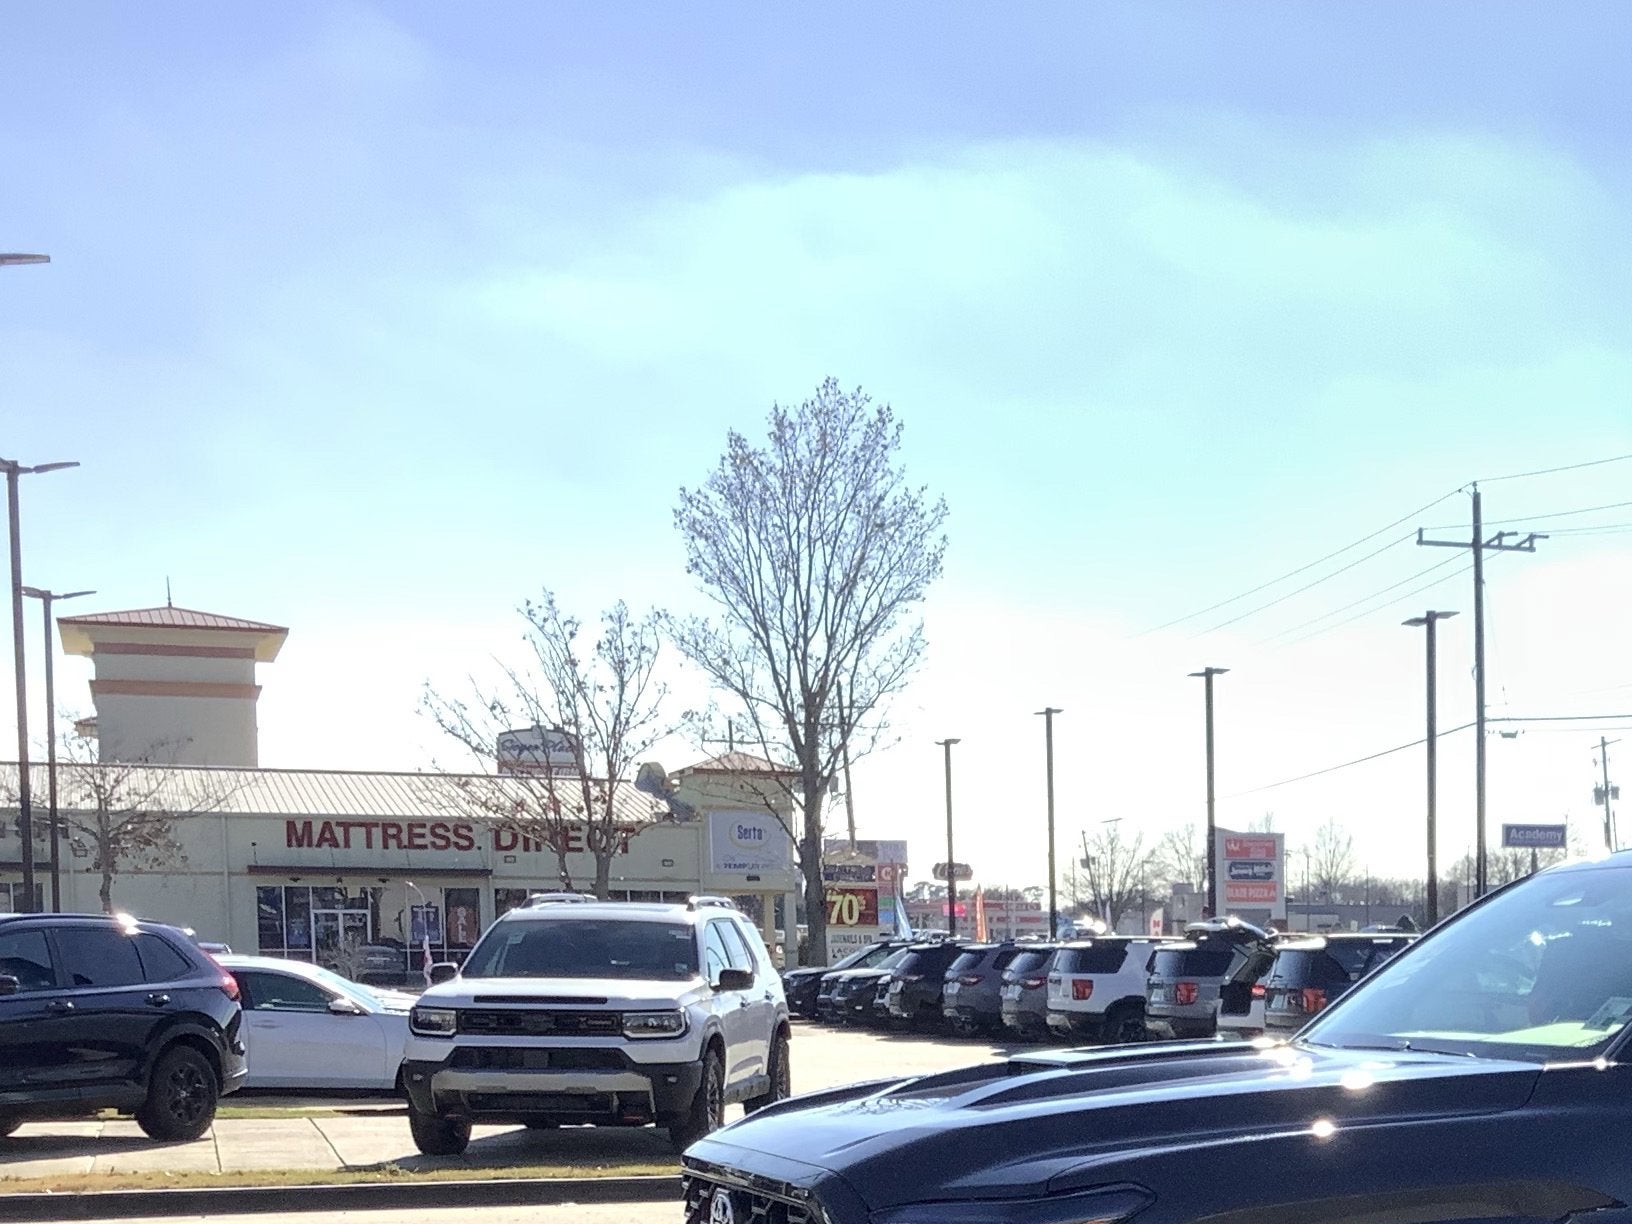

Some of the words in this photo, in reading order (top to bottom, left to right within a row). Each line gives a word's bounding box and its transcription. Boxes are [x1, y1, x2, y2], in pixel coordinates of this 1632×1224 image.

[286, 820, 475, 850] MATTRESS
[737, 824, 763, 840] Serta
[1510, 827, 1563, 843] Academy
